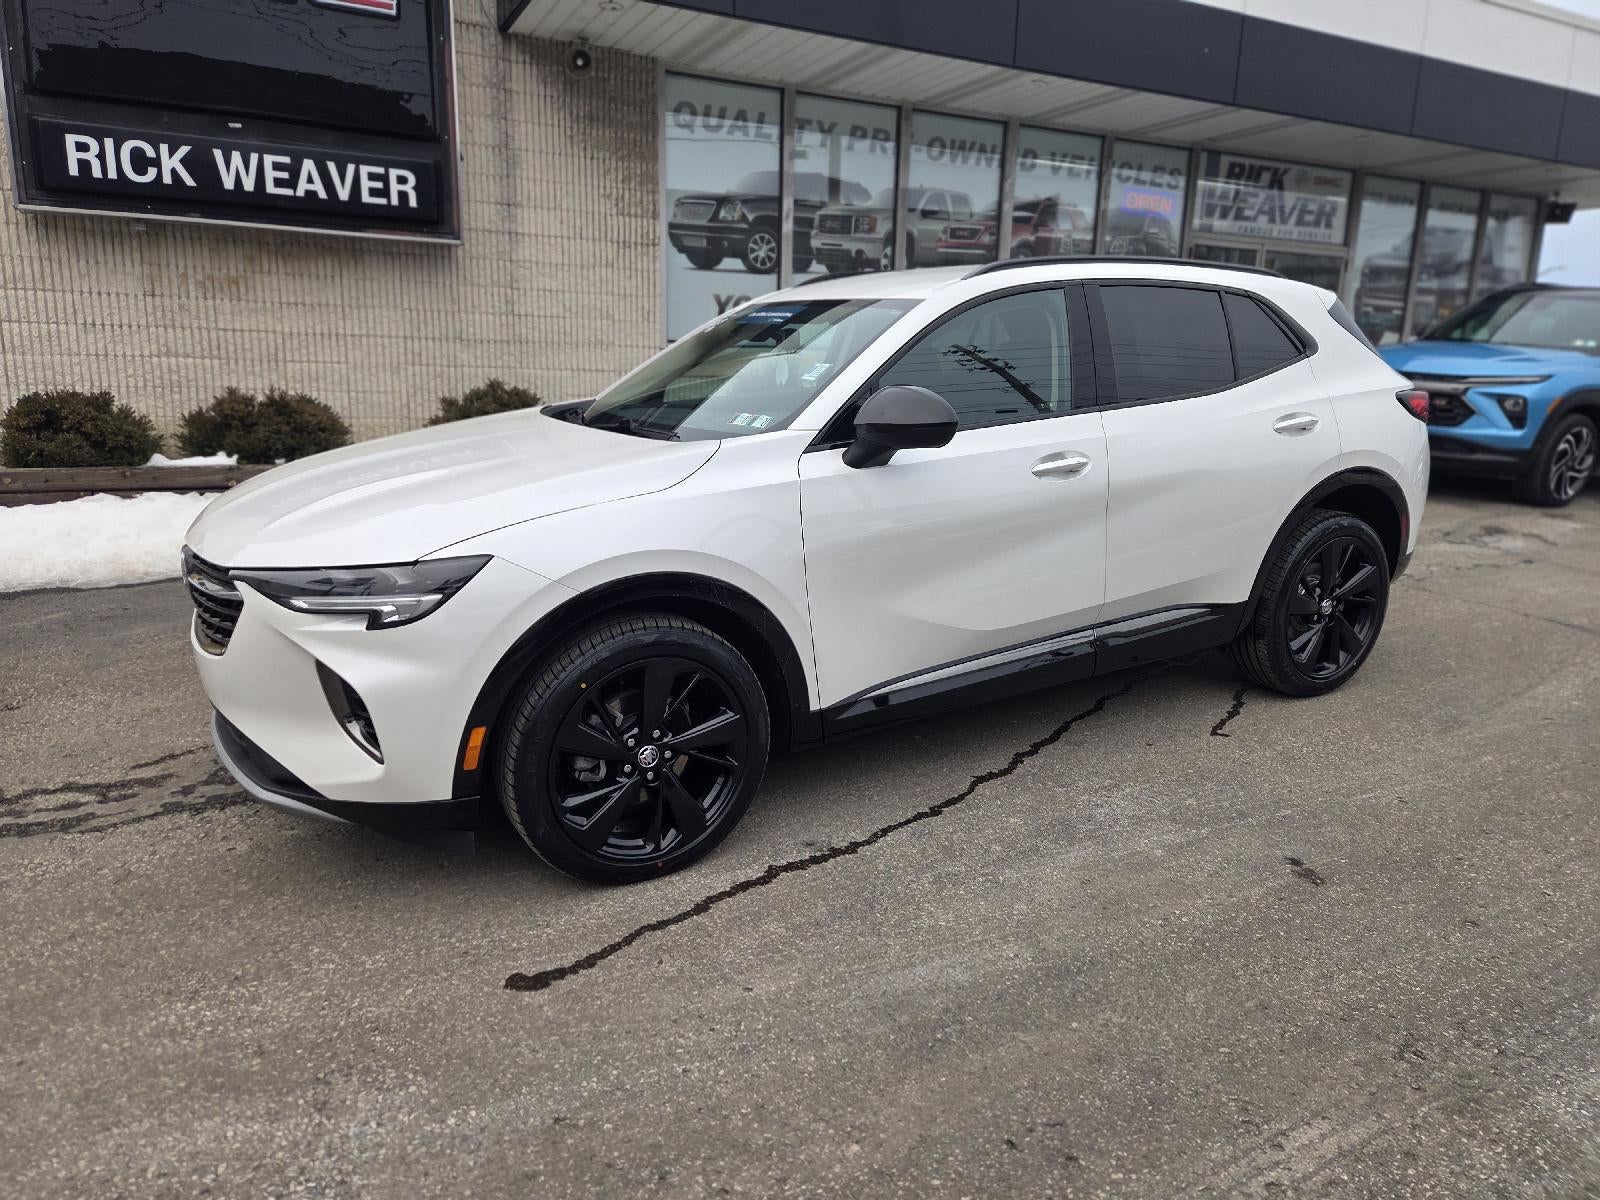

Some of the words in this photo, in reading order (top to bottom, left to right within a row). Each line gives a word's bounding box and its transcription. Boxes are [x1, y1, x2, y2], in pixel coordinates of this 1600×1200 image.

[672, 101, 838, 147] QUALTY
[64, 133, 197, 187] RICK
[213, 148, 418, 208] WEAVER
[1225, 161, 1291, 190] RICK
[1127, 192, 1174, 214] OPEN
[1204, 188, 1338, 229] WEAVER
